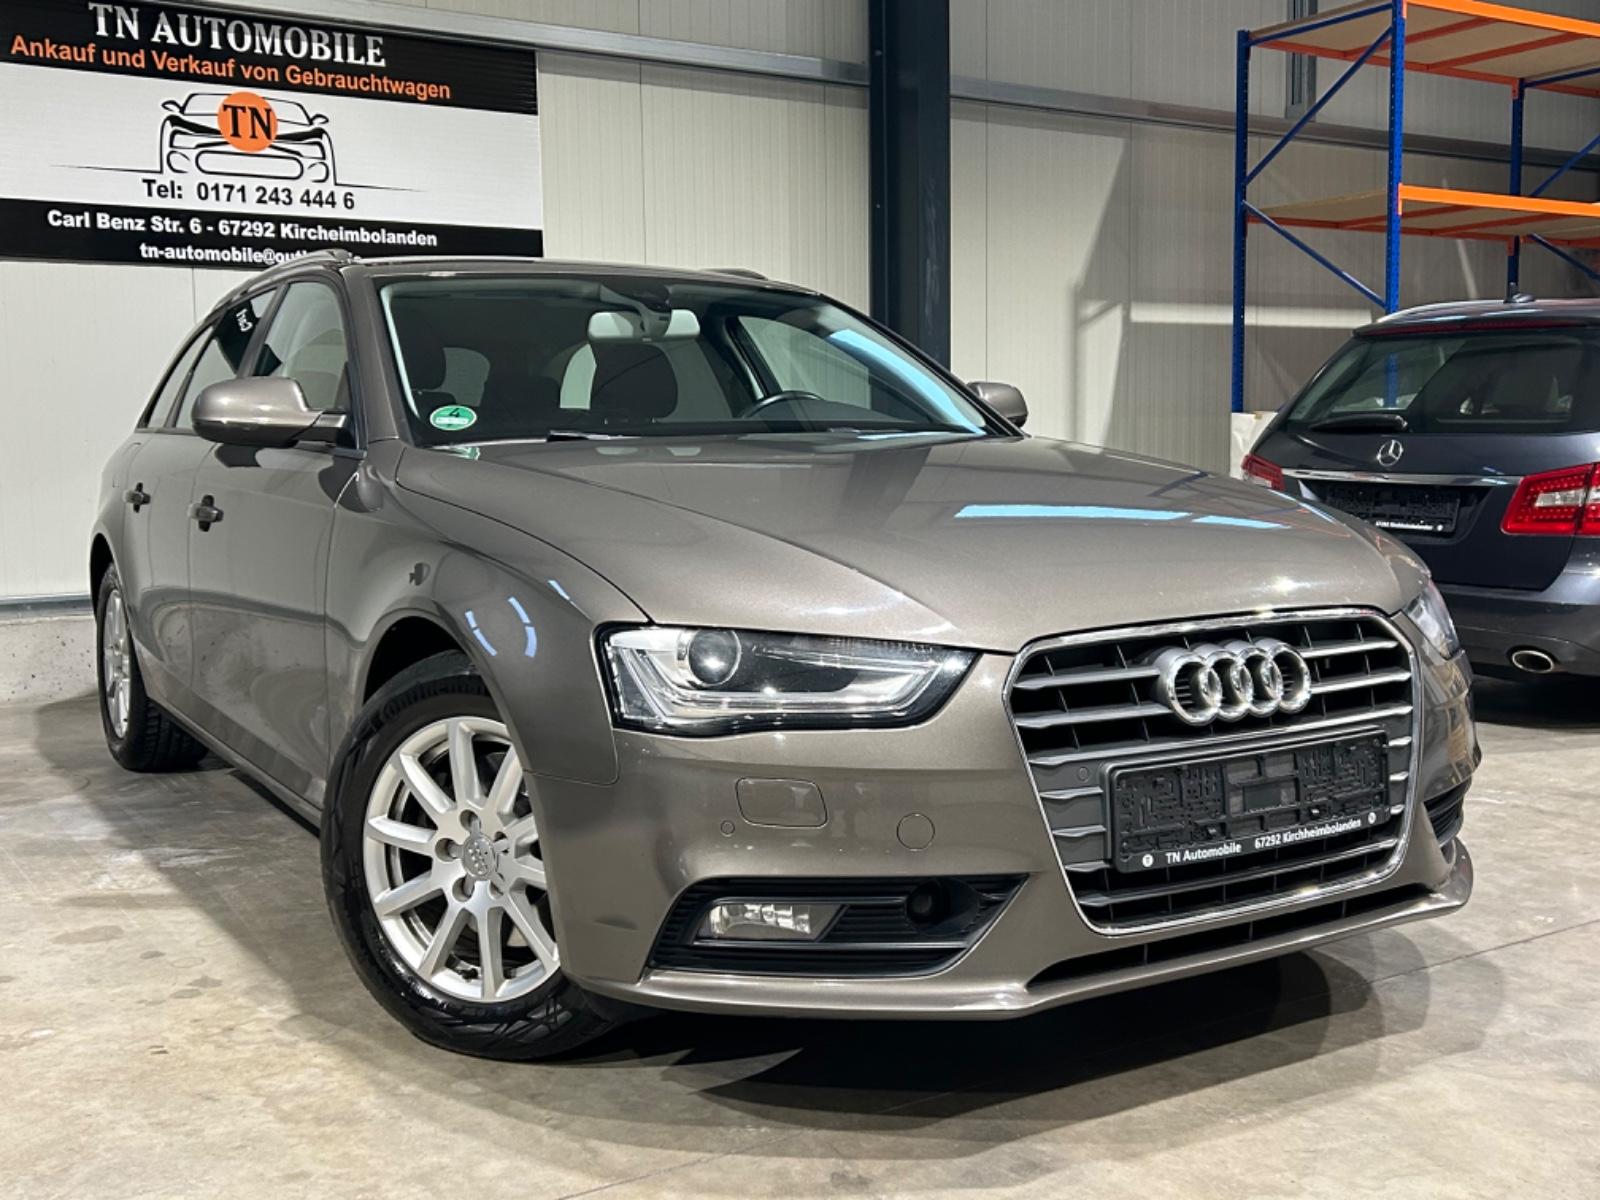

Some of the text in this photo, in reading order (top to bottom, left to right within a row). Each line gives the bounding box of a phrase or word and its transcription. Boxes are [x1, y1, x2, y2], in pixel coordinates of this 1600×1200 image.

[88, 2, 386, 67] TN AUTOMOBILE
[10, 34, 451, 100] Ankauf und Verkauf von Gebrauchtwagen
[223, 104, 272, 140] TN
[142, 179, 355, 210] Tel: 0171 243 444 6
[47, 210, 90, 228] Carl
[96, 212, 146, 231] Benz
[150, 216, 185, 233] Str.
[189, 218, 202, 234] 6
[218, 219, 275, 238] 67292
[280, 223, 438, 247] Kircheimbolanden
[449, 407, 460, 418] 4
[1165, 841, 1242, 864] TN Automobile
[1255, 833, 1281, 849] 67292
